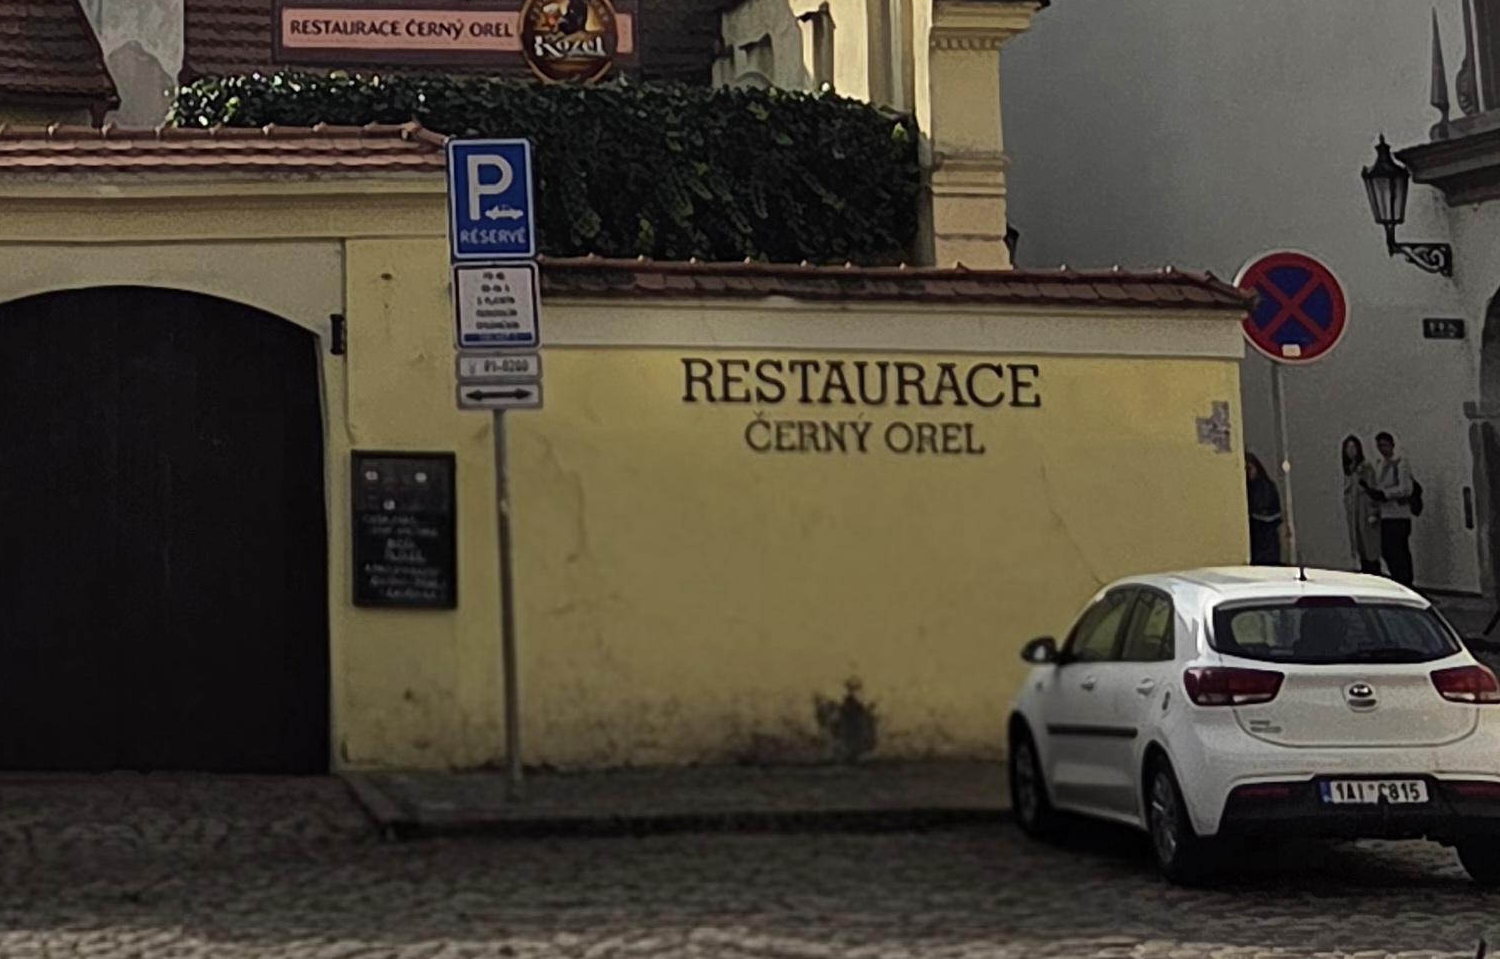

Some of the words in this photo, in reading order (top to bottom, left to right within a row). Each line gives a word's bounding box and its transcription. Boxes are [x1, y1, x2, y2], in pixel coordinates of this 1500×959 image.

[290, 18, 401, 37] RESTAURACE
[405, 16, 465, 40] ČERNÝ
[469, 21, 514, 39] OREL
[533, 34, 607, 58] Kozel
[466, 154, 514, 221] P
[680, 357, 1042, 409] RESTAURACE
[744, 411, 874, 453] ČERNÝ
[884, 420, 987, 455] OREL
